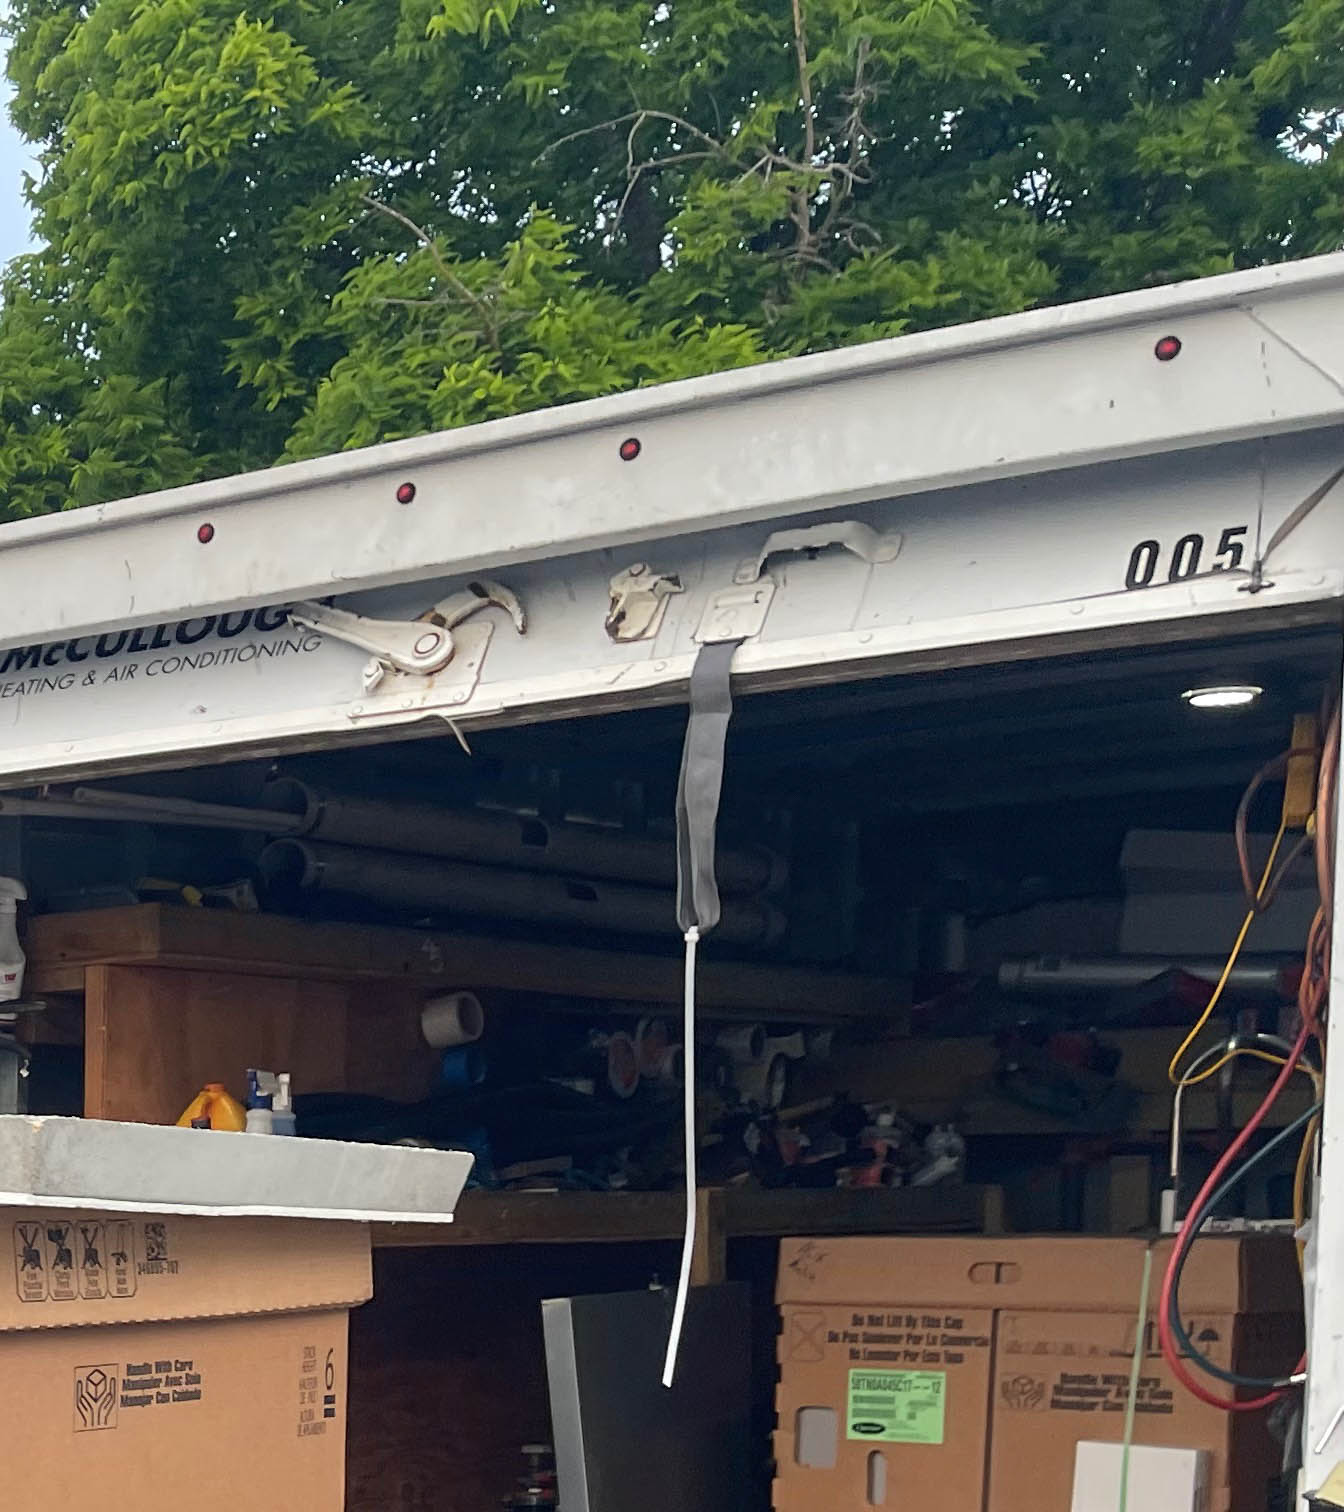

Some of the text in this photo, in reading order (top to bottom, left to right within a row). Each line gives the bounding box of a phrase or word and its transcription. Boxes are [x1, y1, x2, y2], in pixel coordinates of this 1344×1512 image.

[1125, 526, 1248, 591] 005
[82, 669, 97, 687] &
[103, 662, 139, 683] AIR
[146, 634, 324, 677] CONDITIONING
[325, 1347, 334, 1391] 6
